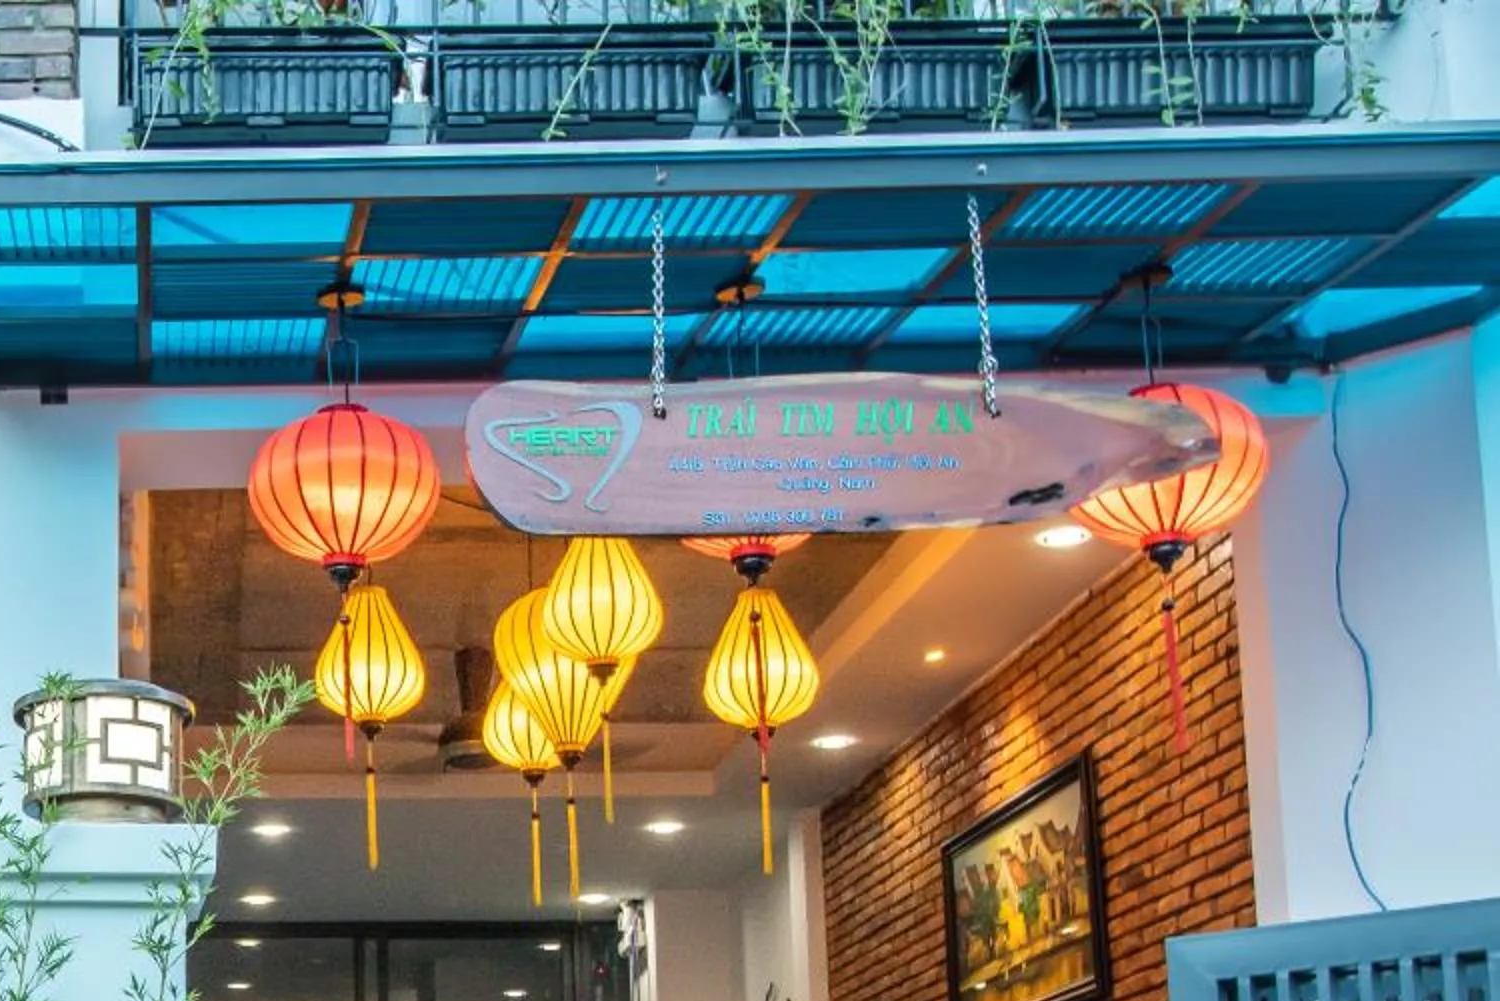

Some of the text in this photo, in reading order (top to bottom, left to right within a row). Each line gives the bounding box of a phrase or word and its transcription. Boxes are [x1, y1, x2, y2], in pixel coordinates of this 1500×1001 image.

[781, 401, 835, 437] TIM
[928, 399, 975, 434] AN
[509, 427, 616, 444] HEART
